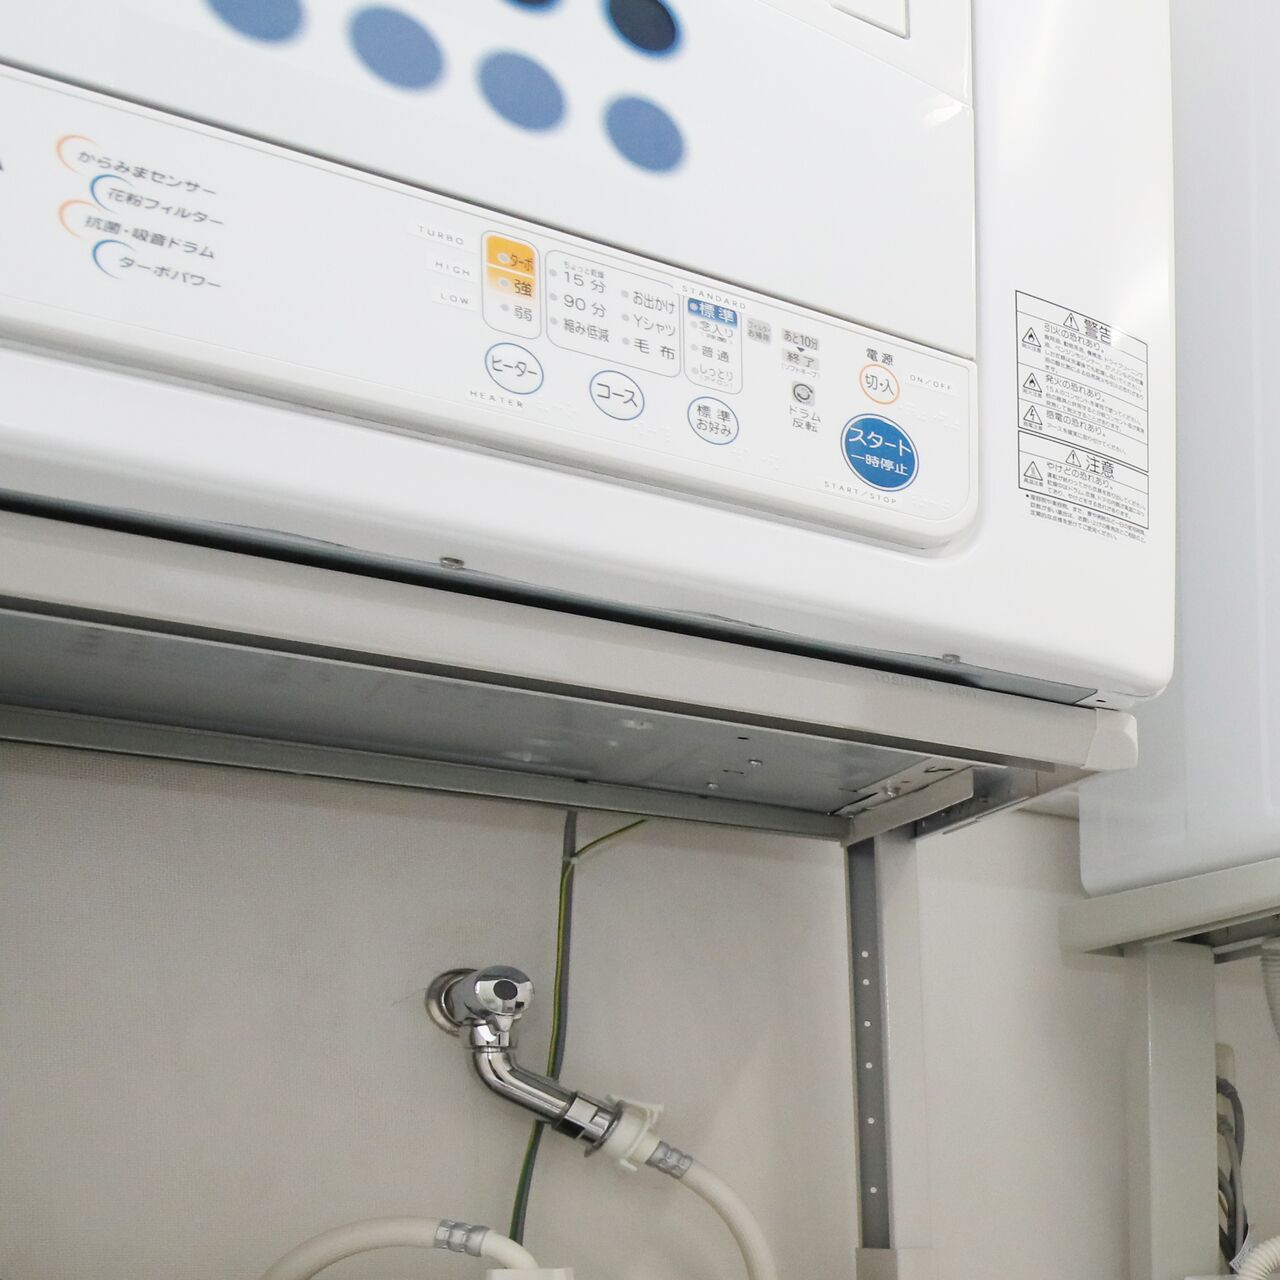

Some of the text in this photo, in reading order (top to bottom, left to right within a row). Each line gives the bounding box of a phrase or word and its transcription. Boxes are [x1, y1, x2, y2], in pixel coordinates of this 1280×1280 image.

[77, 151, 217, 195] からみまセンサー
[107, 187, 224, 225] 花粉フィルター
[84, 215, 215, 260] 抗菌・吸音ドラム
[417, 224, 465, 246] TURBO
[435, 261, 470, 277] HIGH
[510, 254, 533, 272] ターボ
[440, 292, 470, 305] LOW
[514, 279, 532, 297] 強
[682, 285, 746, 310] STANDARD
[633, 290, 675, 314] お出かけ
[698, 301, 735, 324] 標準
[514, 305, 533, 322] 弱
[563, 318, 610, 343] 縮み低減
[633, 313, 676, 337] Yシャツ
[698, 320, 734, 338] 念入り
[1084, 318, 1111, 346] 警告
[783, 330, 819, 351] あと10分
[1044, 322, 1105, 354] 引火の恐れあり。
[701, 345, 730, 363] 普通
[786, 351, 816, 368] 終了
[866, 348, 894, 366] 電源
[491, 355, 538, 377] ヒーター
[469, 389, 524, 409] HEATER
[596, 382, 638, 408] コース
[1045, 373, 1106, 403] 発火の恐れあり。
[696, 404, 732, 423] 標準
[788, 405, 822, 423] ドラム
[1046, 409, 1107, 438] 感電の恐れあり。
[696, 418, 732, 437] お好み
[792, 418, 819, 433] 反転
[848, 427, 912, 456] スタート
[851, 454, 909, 476] 一時停止
[1047, 461, 1114, 491] やけどの恐れあり。
[1086, 455, 1115, 480] 注意
[824, 481, 898, 504] START/STOP
